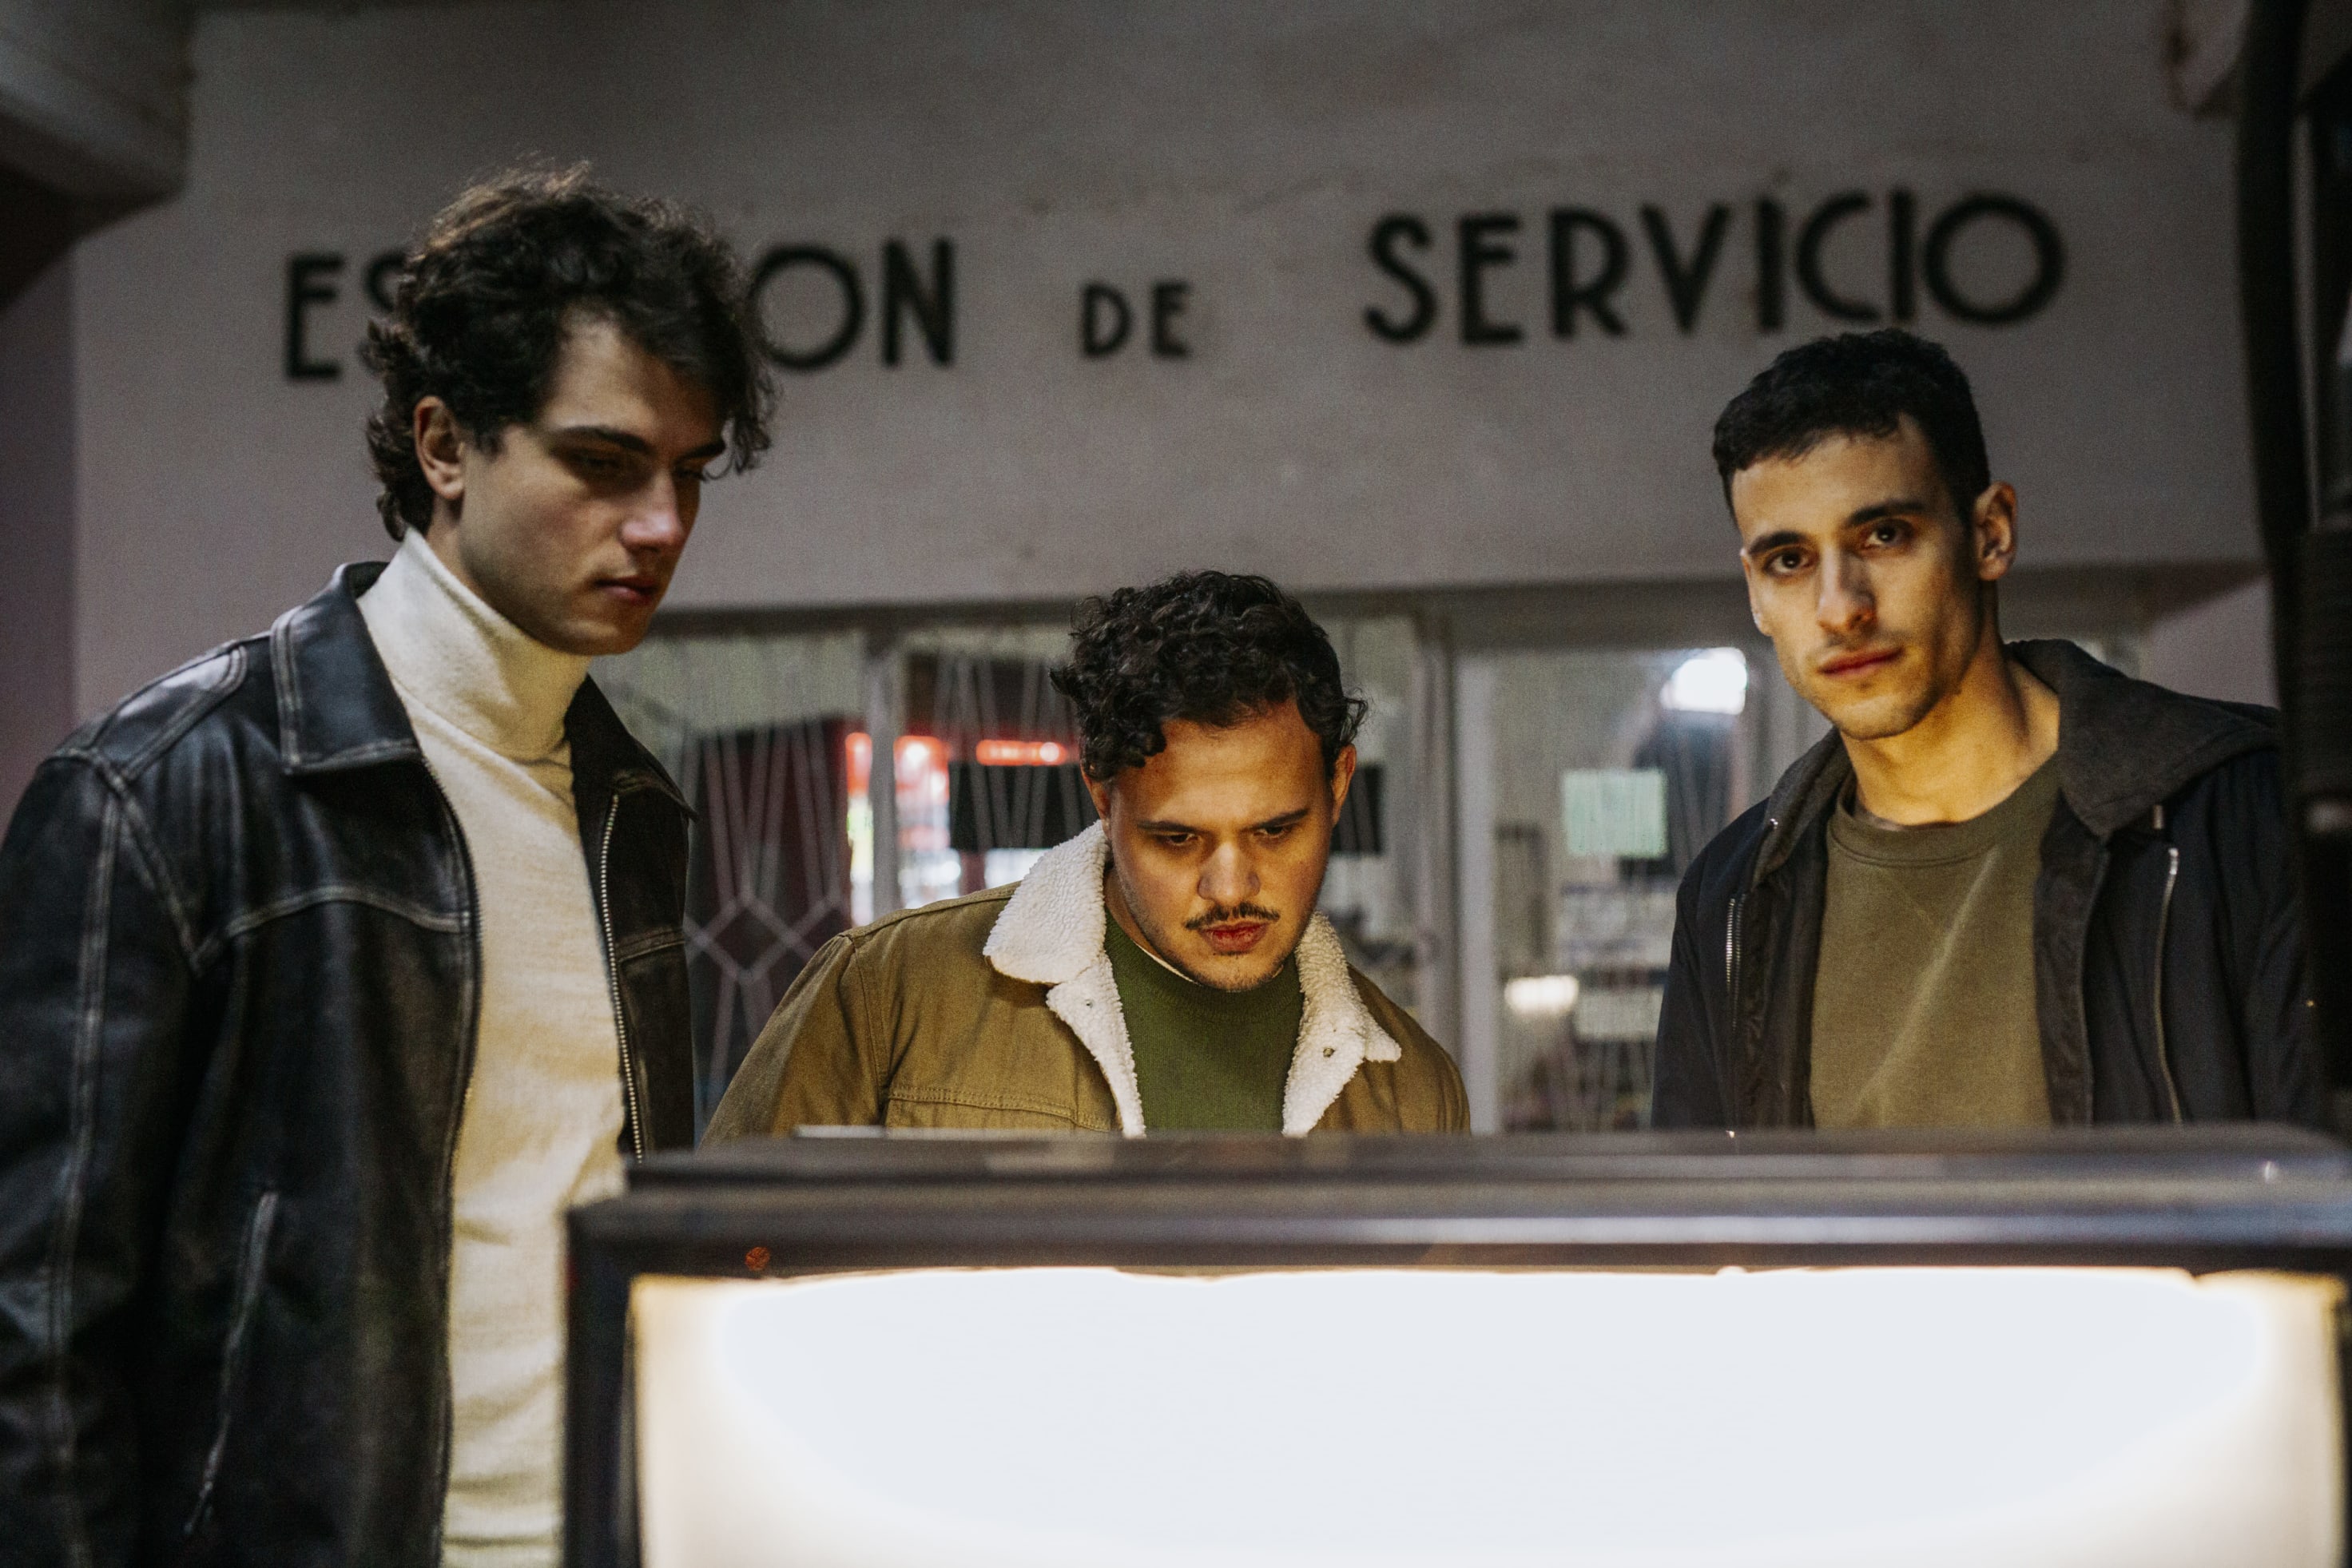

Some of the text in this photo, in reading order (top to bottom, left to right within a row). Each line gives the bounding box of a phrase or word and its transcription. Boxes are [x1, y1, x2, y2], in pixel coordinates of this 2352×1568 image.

[285, 189, 2067, 379] ESON DE SERVICIO
